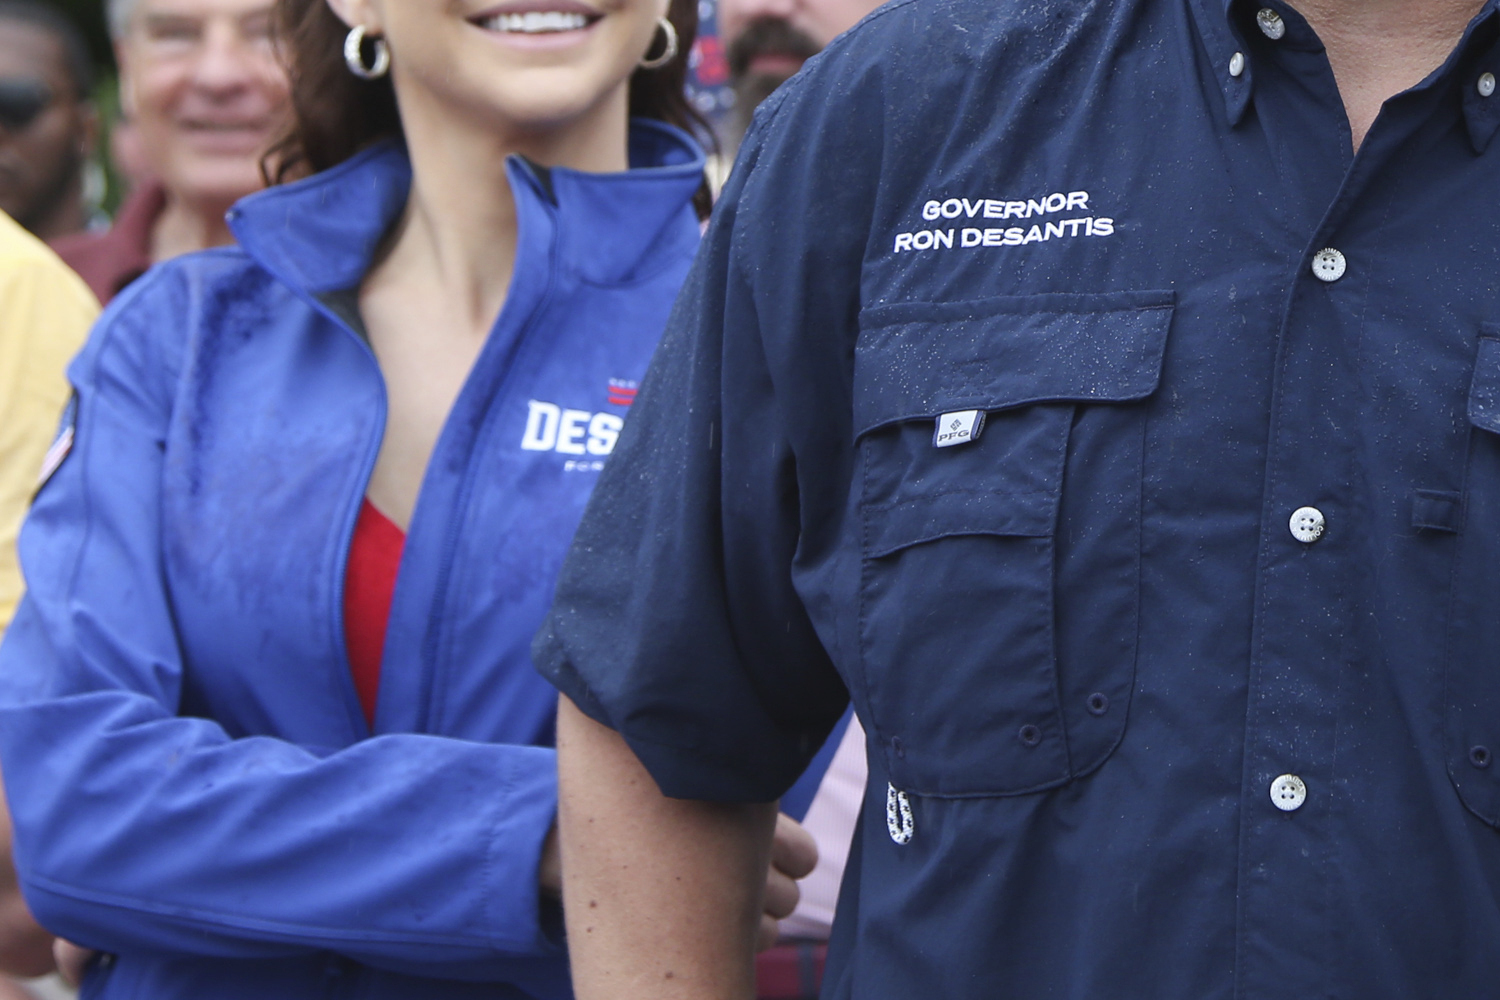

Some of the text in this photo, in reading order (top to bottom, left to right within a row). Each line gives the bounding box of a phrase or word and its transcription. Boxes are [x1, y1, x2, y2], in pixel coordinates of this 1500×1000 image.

[921, 190, 1090, 222] GOVERNOR
[893, 216, 1115, 253] RON DESANTIS
[938, 429, 970, 442] PFG
